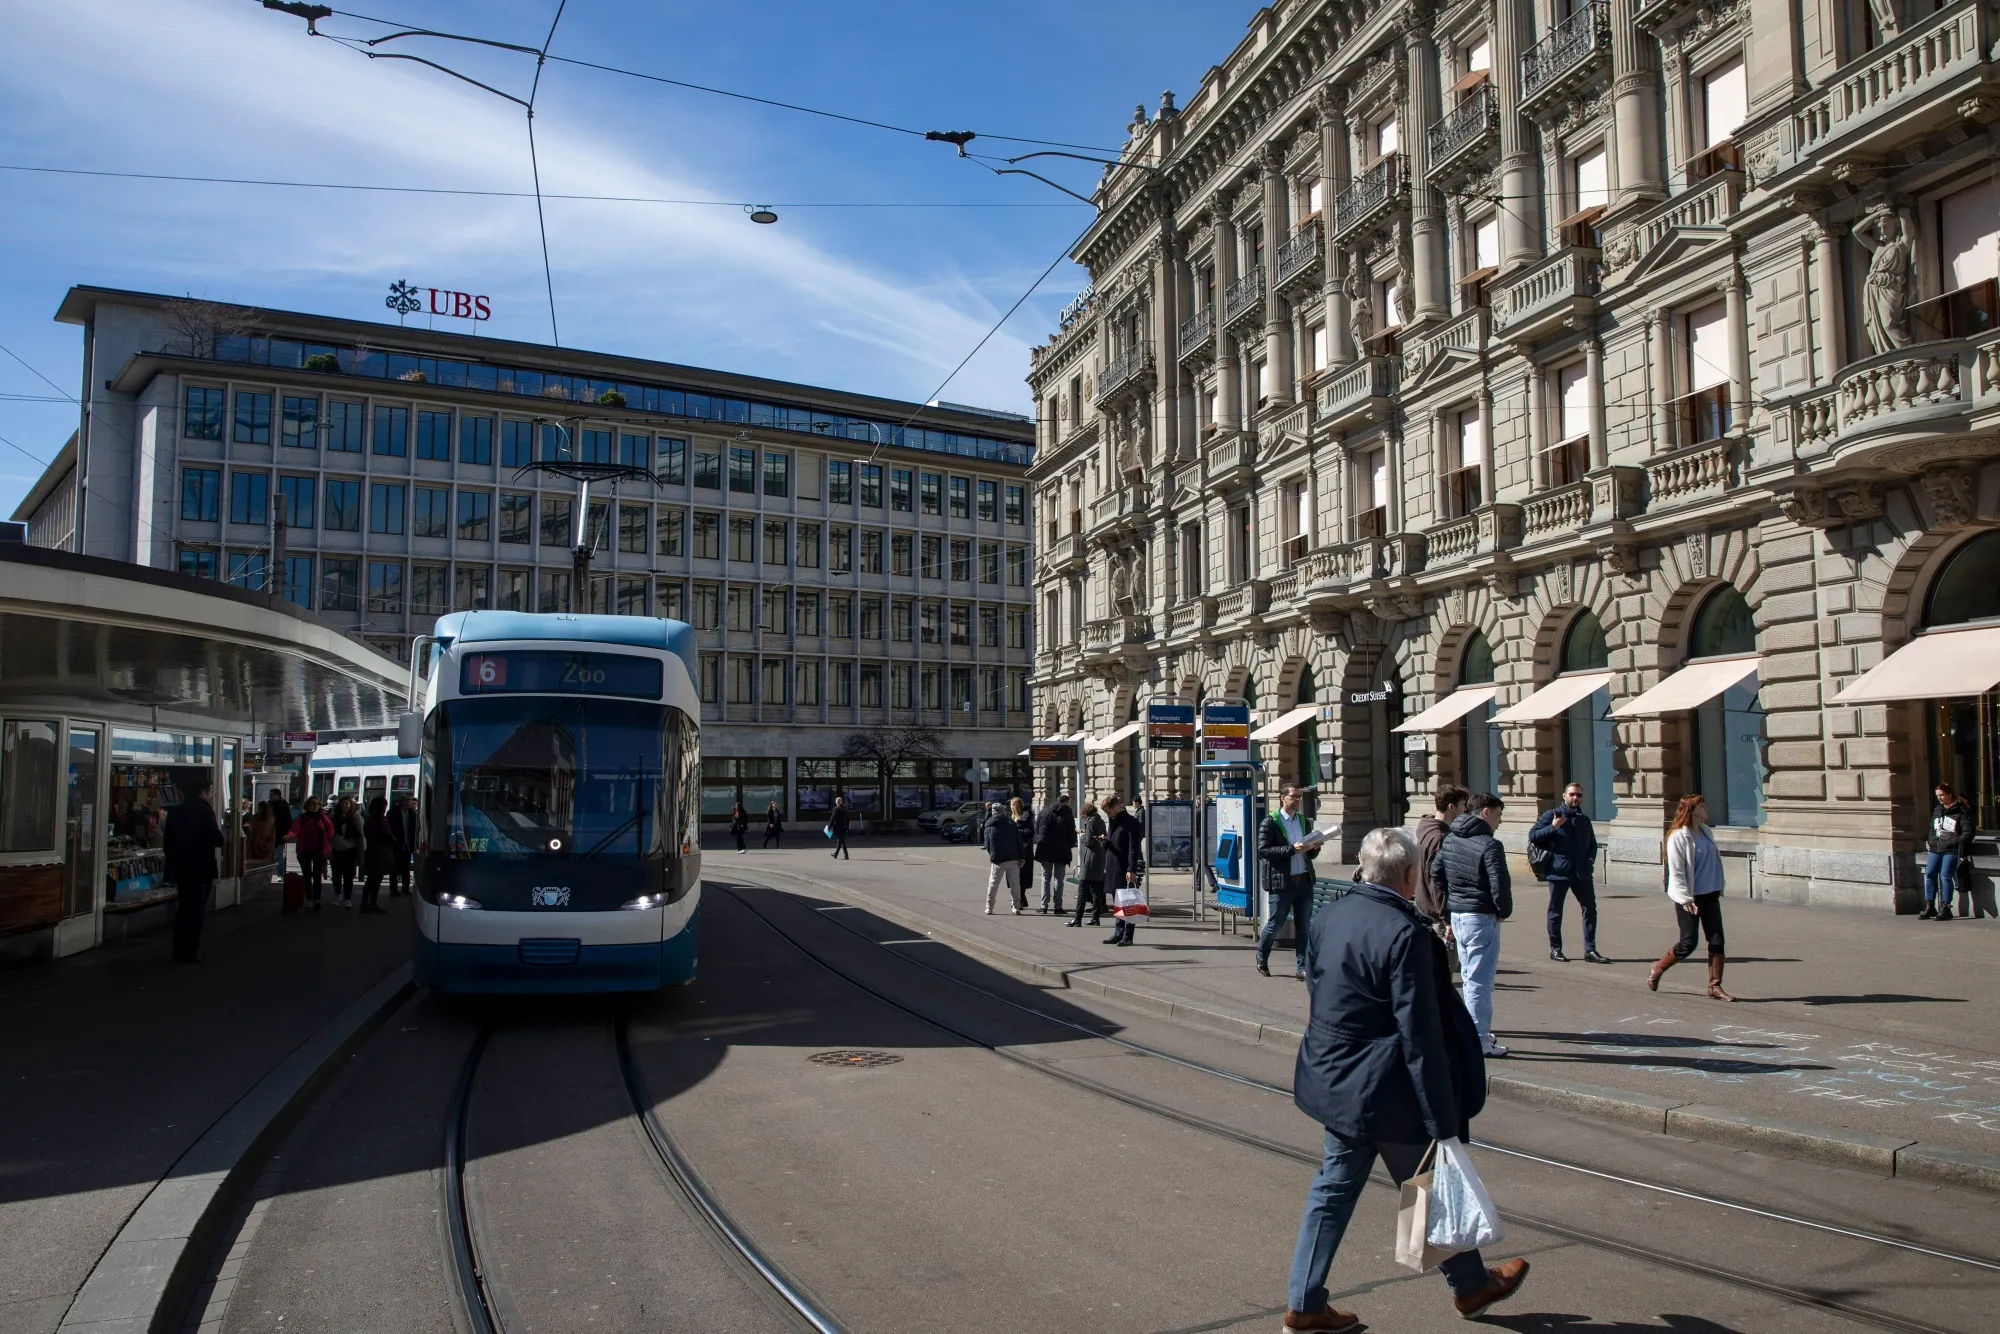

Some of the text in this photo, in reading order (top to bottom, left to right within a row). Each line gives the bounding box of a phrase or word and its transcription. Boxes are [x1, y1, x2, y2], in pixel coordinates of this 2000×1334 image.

[428, 288, 491, 321] UBS
[480, 661, 496, 682] 6
[564, 662, 606, 684] Zoo
[1351, 691, 1387, 703] CREDIT SUISSE
[1155, 740, 1161, 748] 7
[1208, 741, 1216, 749] 17
[471, 840, 487, 851] 03
[1618, 1016, 1686, 1024] IF
[1712, 1024, 1822, 1041] THE
[1591, 1044, 1660, 1055] OF
[1788, 1083, 1908, 1107] THE
